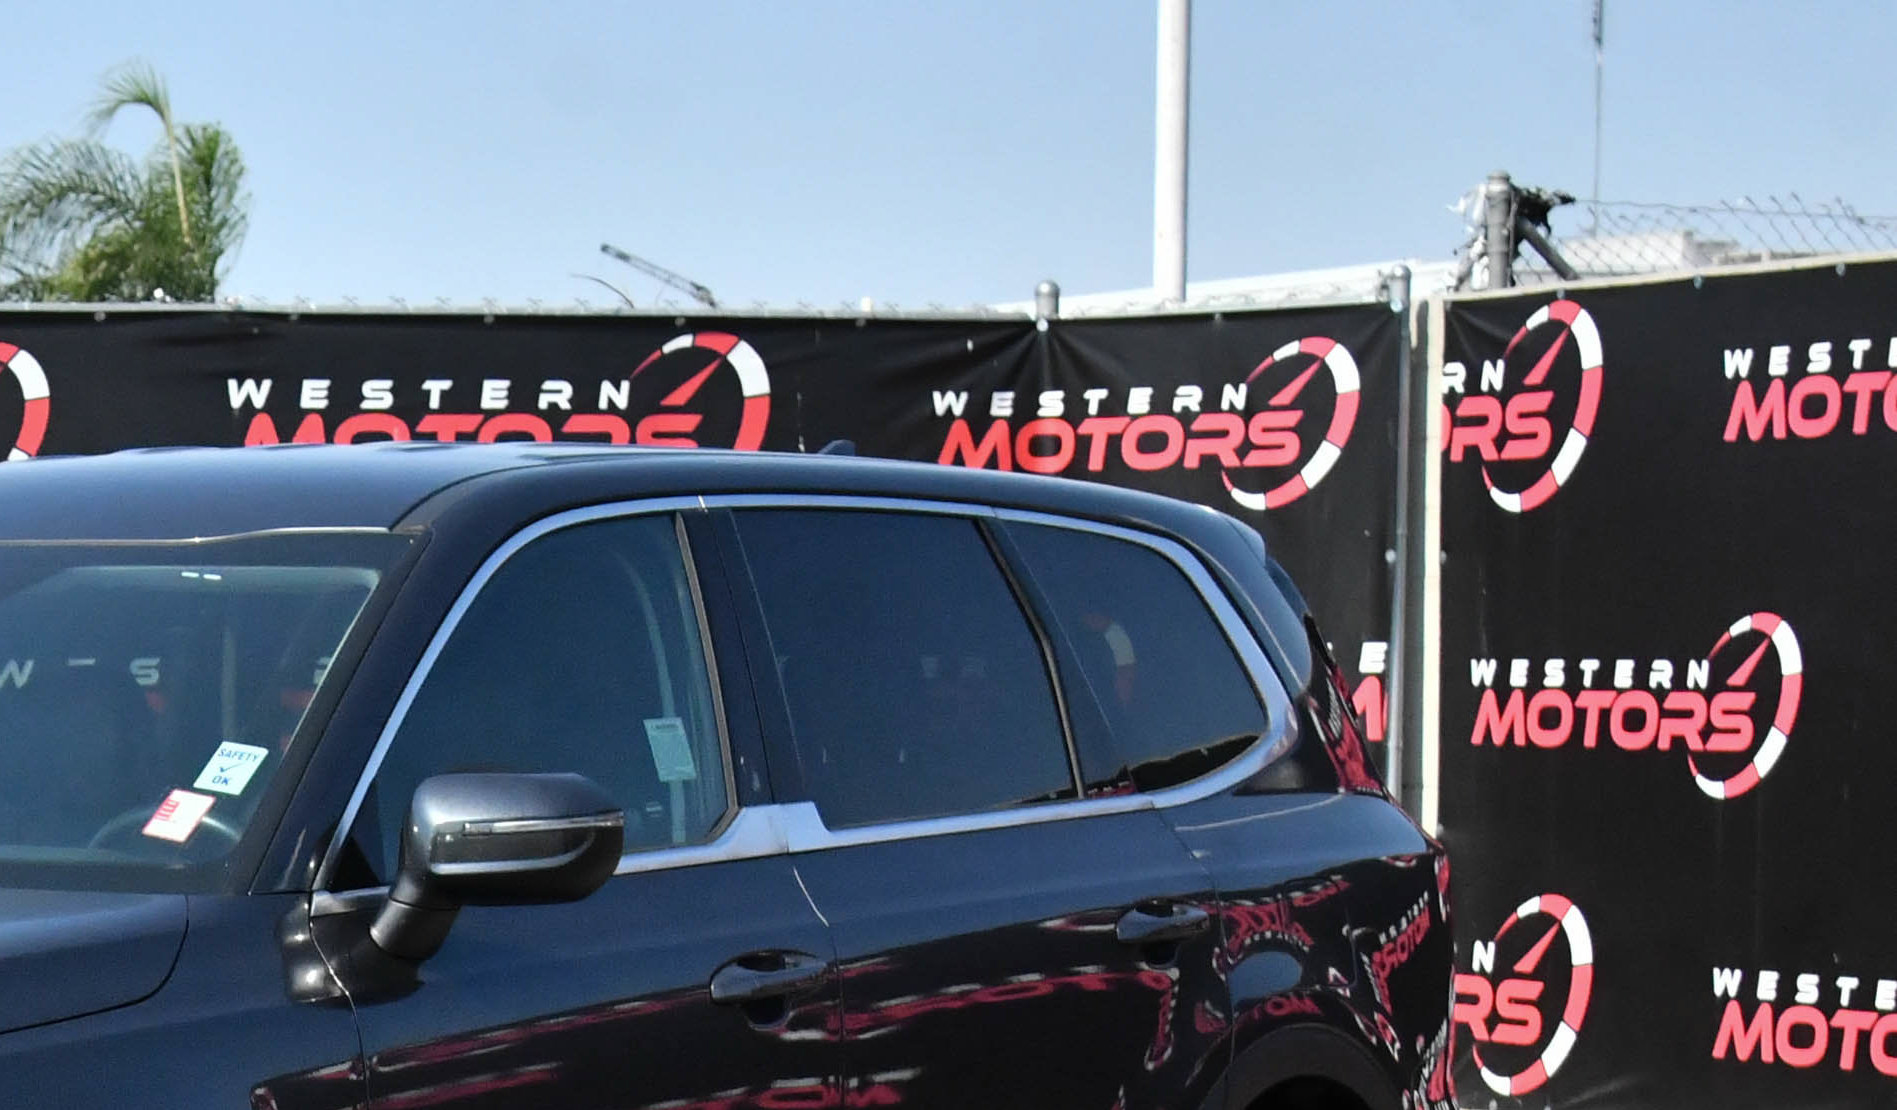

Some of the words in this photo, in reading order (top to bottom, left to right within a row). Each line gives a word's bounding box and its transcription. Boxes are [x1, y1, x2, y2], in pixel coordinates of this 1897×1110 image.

[227, 378, 631, 410] WESTERN
[932, 383, 1248, 417] WESTERN
[937, 410, 1304, 474] MOTORS
[1470, 659, 1710, 690] WESTERN
[1470, 688, 1757, 753] MOTORS
[217, 747, 261, 762] SAFETY
[211, 775, 233, 786] OK
